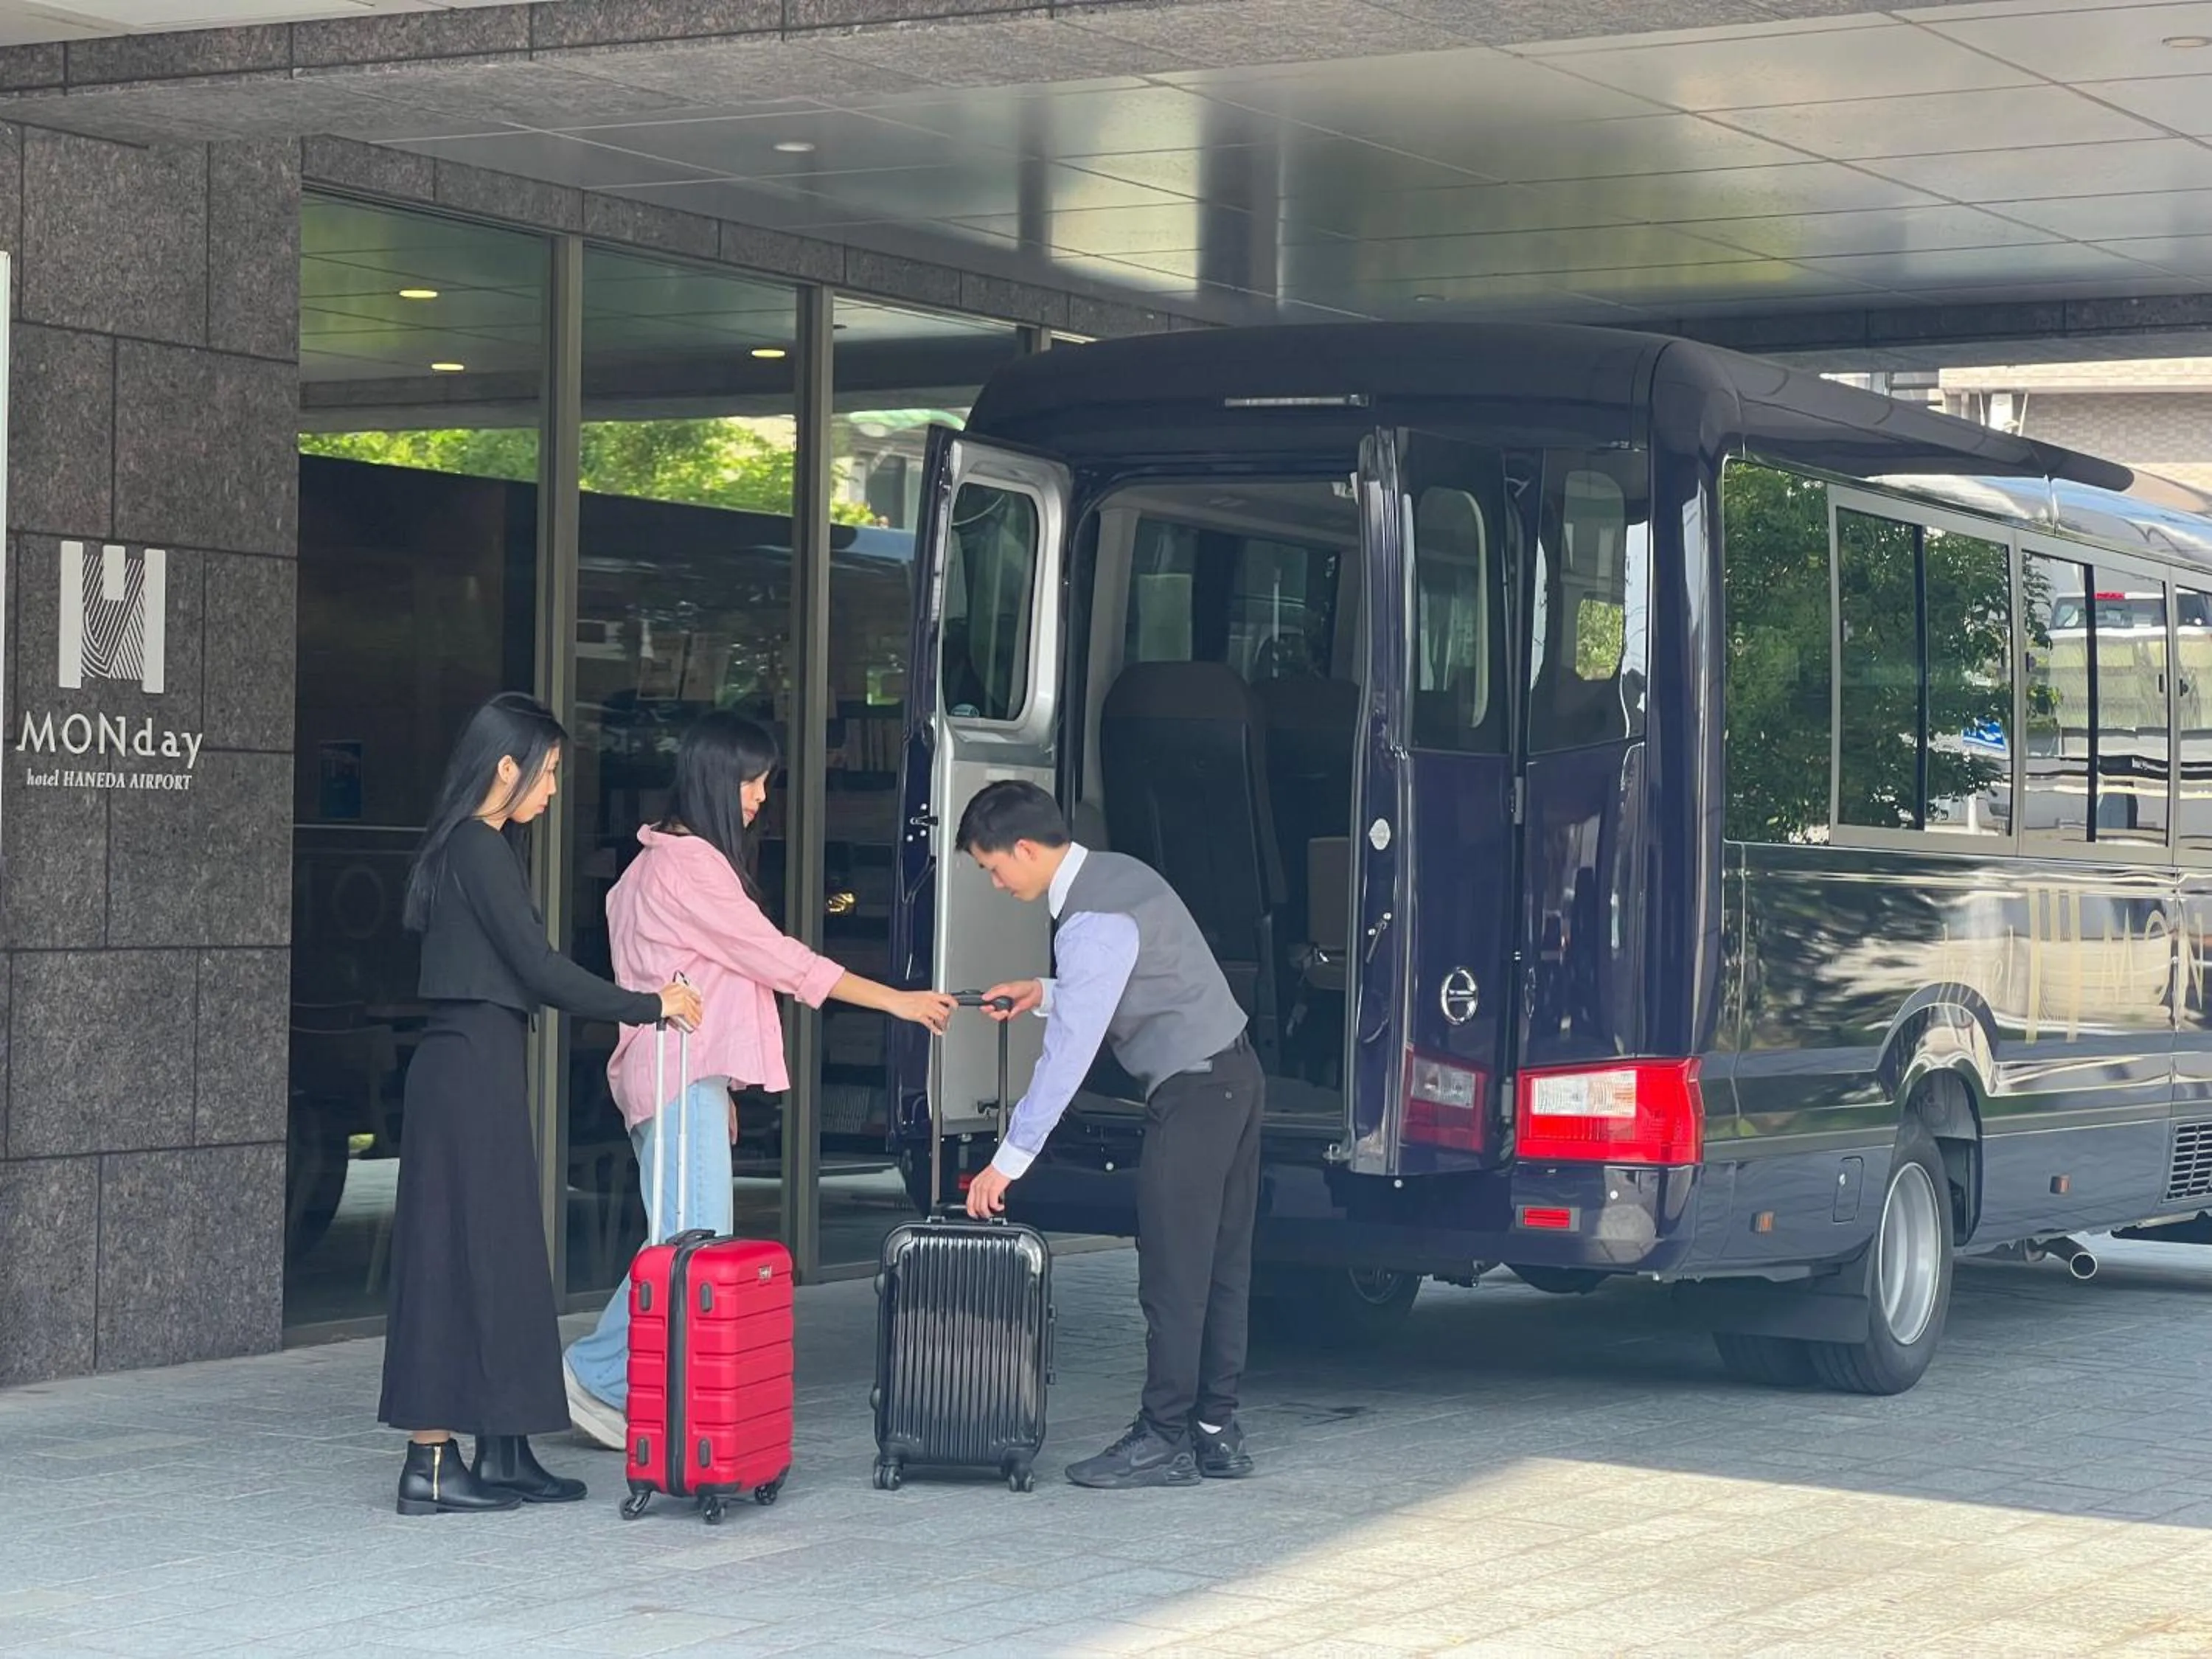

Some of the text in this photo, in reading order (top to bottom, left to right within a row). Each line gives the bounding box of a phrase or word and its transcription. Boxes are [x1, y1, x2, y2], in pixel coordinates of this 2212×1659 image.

[15, 710, 203, 769] MONday
[27, 768, 192, 790] hotel HANEDA AIRPORT
